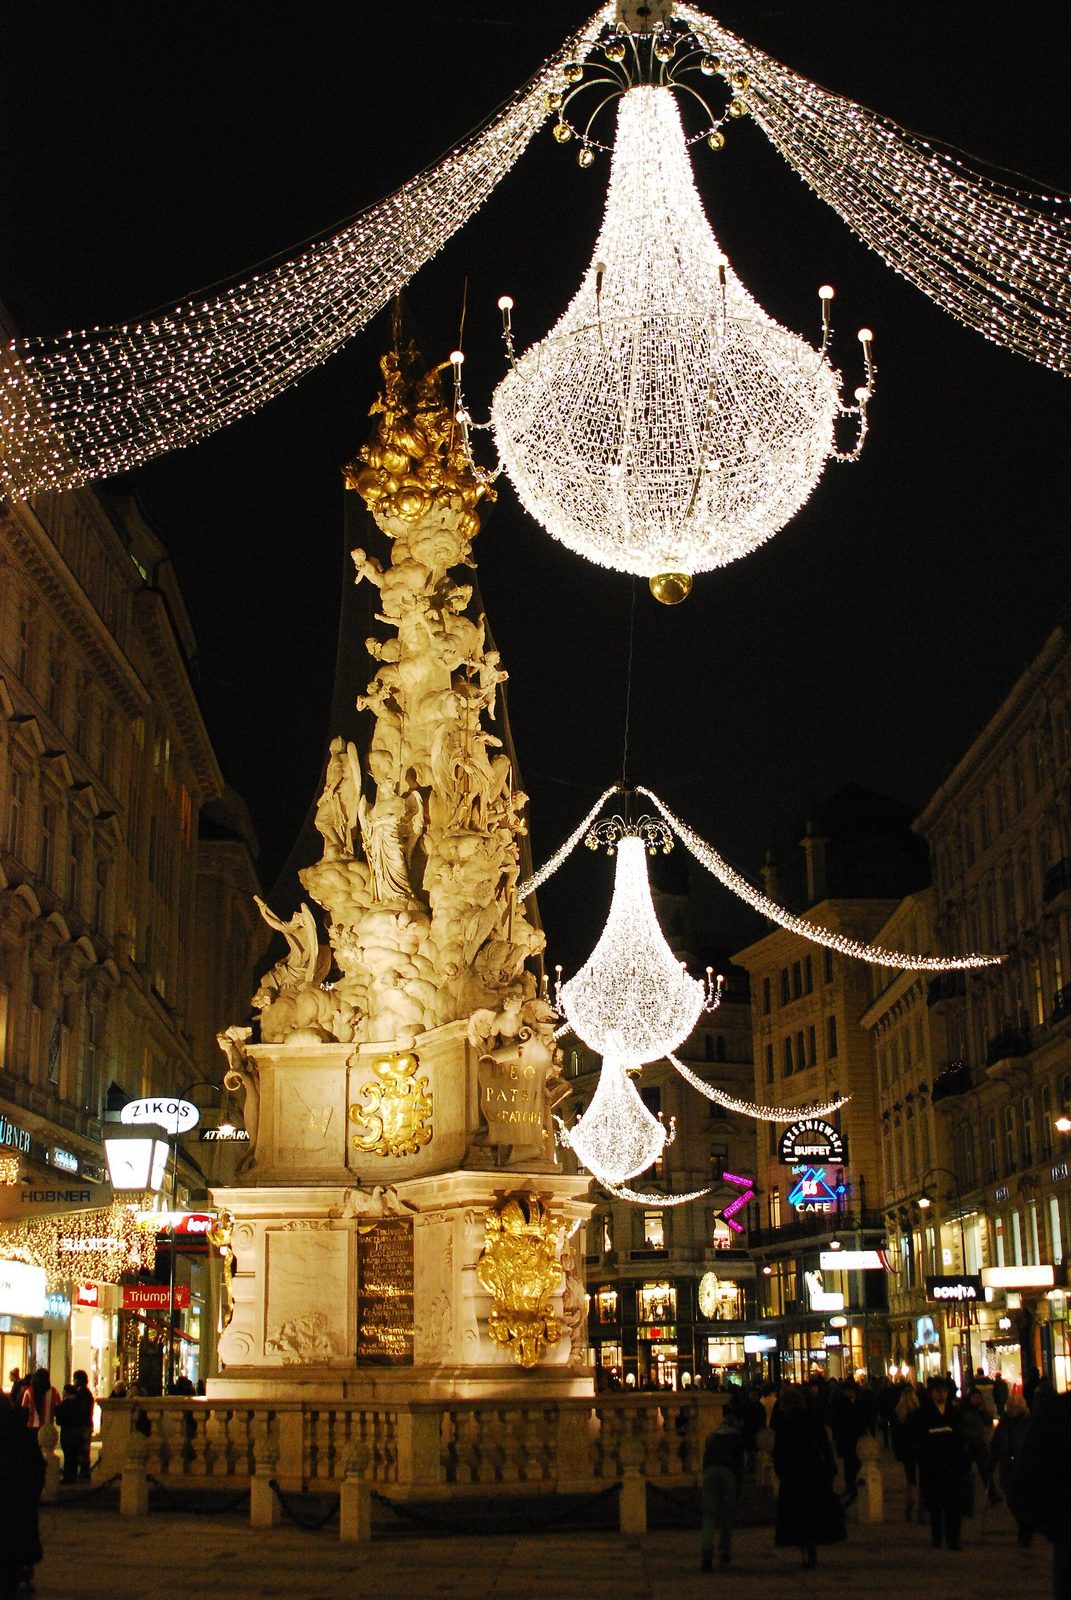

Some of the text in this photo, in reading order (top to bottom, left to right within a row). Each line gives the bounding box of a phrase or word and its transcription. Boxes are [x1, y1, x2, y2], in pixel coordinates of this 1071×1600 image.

[131, 1102, 190, 1118] ZIKOS
[794, 1145, 831, 1155] BUFFET
[795, 1202, 831, 1212] CAFE
[129, 1291, 172, 1304] Triumph
